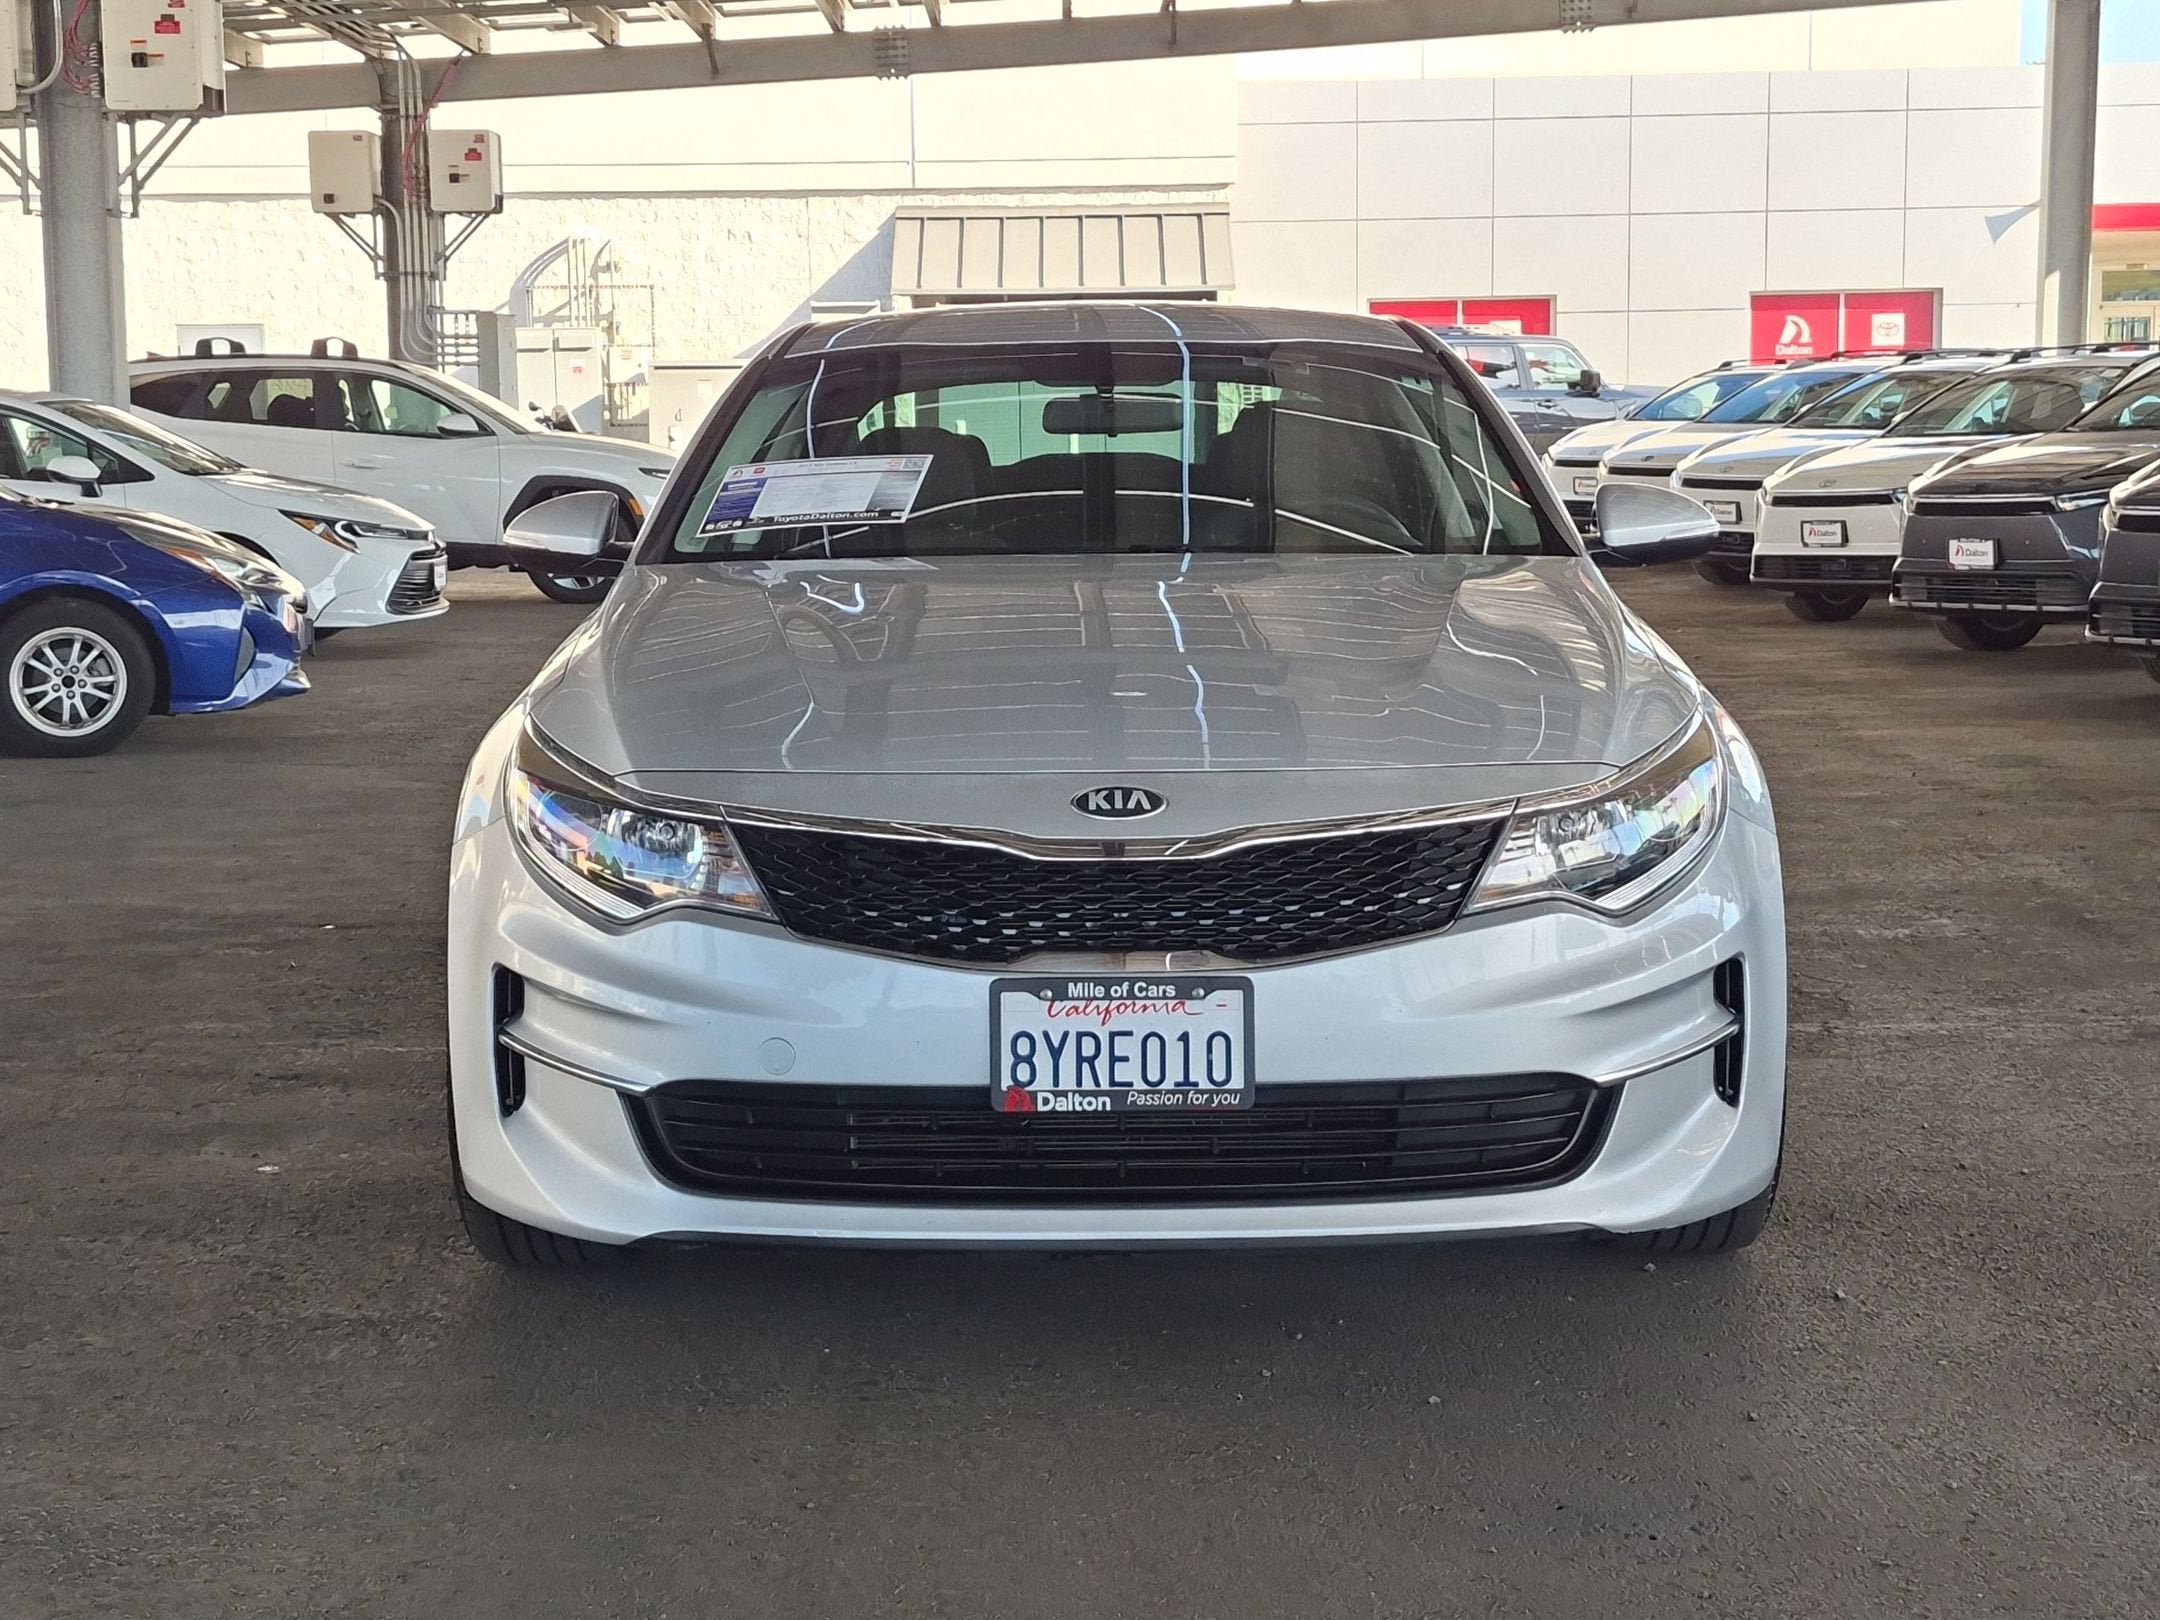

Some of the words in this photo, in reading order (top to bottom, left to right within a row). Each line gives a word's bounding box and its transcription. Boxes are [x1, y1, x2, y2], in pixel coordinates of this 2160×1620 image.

[772, 510, 879, 524] ToyotaDalton.com
[1088, 789, 1152, 811] KIA
[1067, 982, 1105, 998] Mile
[1110, 981, 1129, 998] of
[1133, 981, 1177, 998] Cars
[1046, 1000, 1203, 1026] California
[1009, 1029, 1233, 1088] 8YRE010
[1036, 1091, 1112, 1112] Dalton
[1126, 1090, 1184, 1106] Passion
[1186, 1089, 1209, 1105] for
[1210, 1092, 1241, 1106] you
